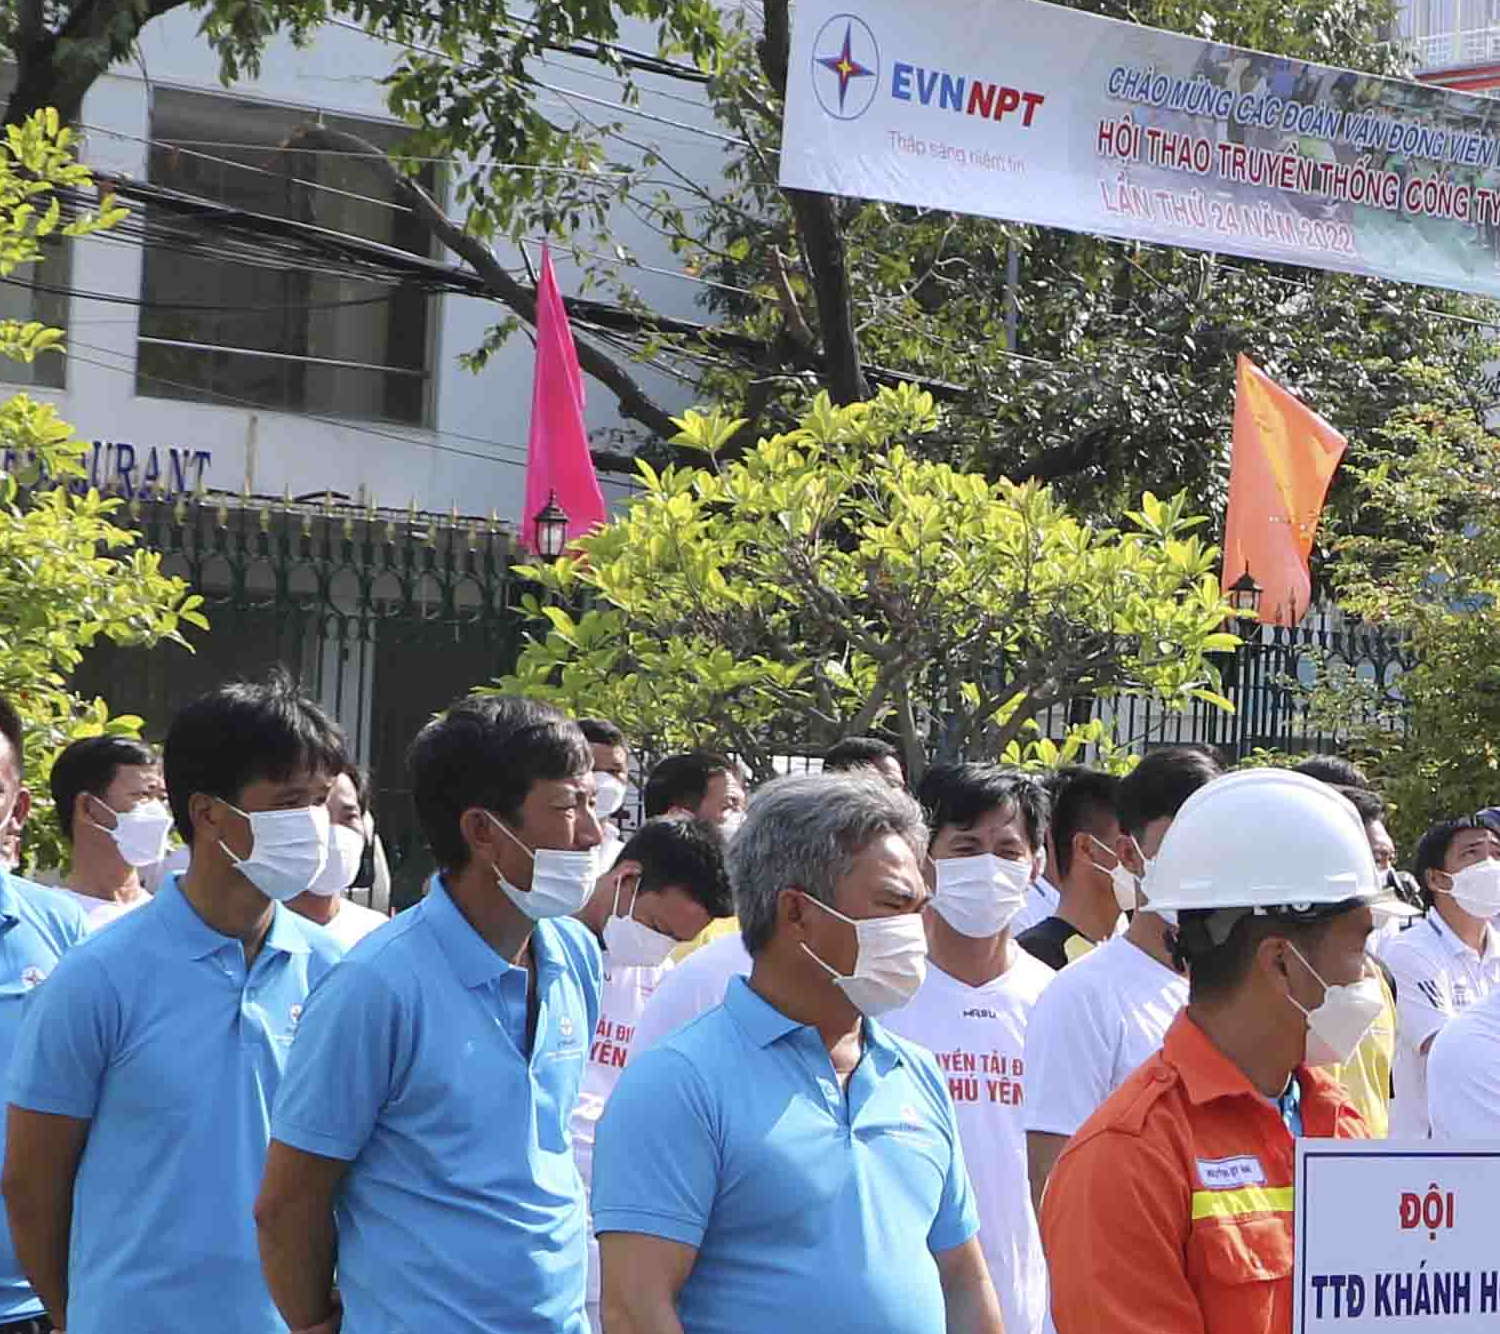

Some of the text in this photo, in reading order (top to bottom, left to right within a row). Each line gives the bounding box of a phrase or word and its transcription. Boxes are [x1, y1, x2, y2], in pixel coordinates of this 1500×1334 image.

[1108, 66, 1169, 104] CHÀO
[1237, 90, 1281, 128] CÁC
[1283, 100, 1341, 139] ĐOÀN
[1344, 111, 1385, 150] VẬN
[1387, 122, 1444, 159] ĐỘNG
[1450, 130, 1493, 165] VIÊN
[1098, 115, 1140, 163] HỘI
[1147, 129, 1210, 172] THAO
[1218, 142, 1313, 193] TRUYỀN
[1320, 155, 1398, 207] THỐNG
[1407, 172, 1469, 218] CÔNG
[1211, 201, 1238, 236] 24
[1300, 218, 1356, 253] 2022
[948, 1074, 978, 1101] HÚ
[1399, 1182, 1454, 1240] ĐỘI
[1311, 1274, 1366, 1319] TTĐ
[1374, 1258, 1471, 1317] KHÁNH
